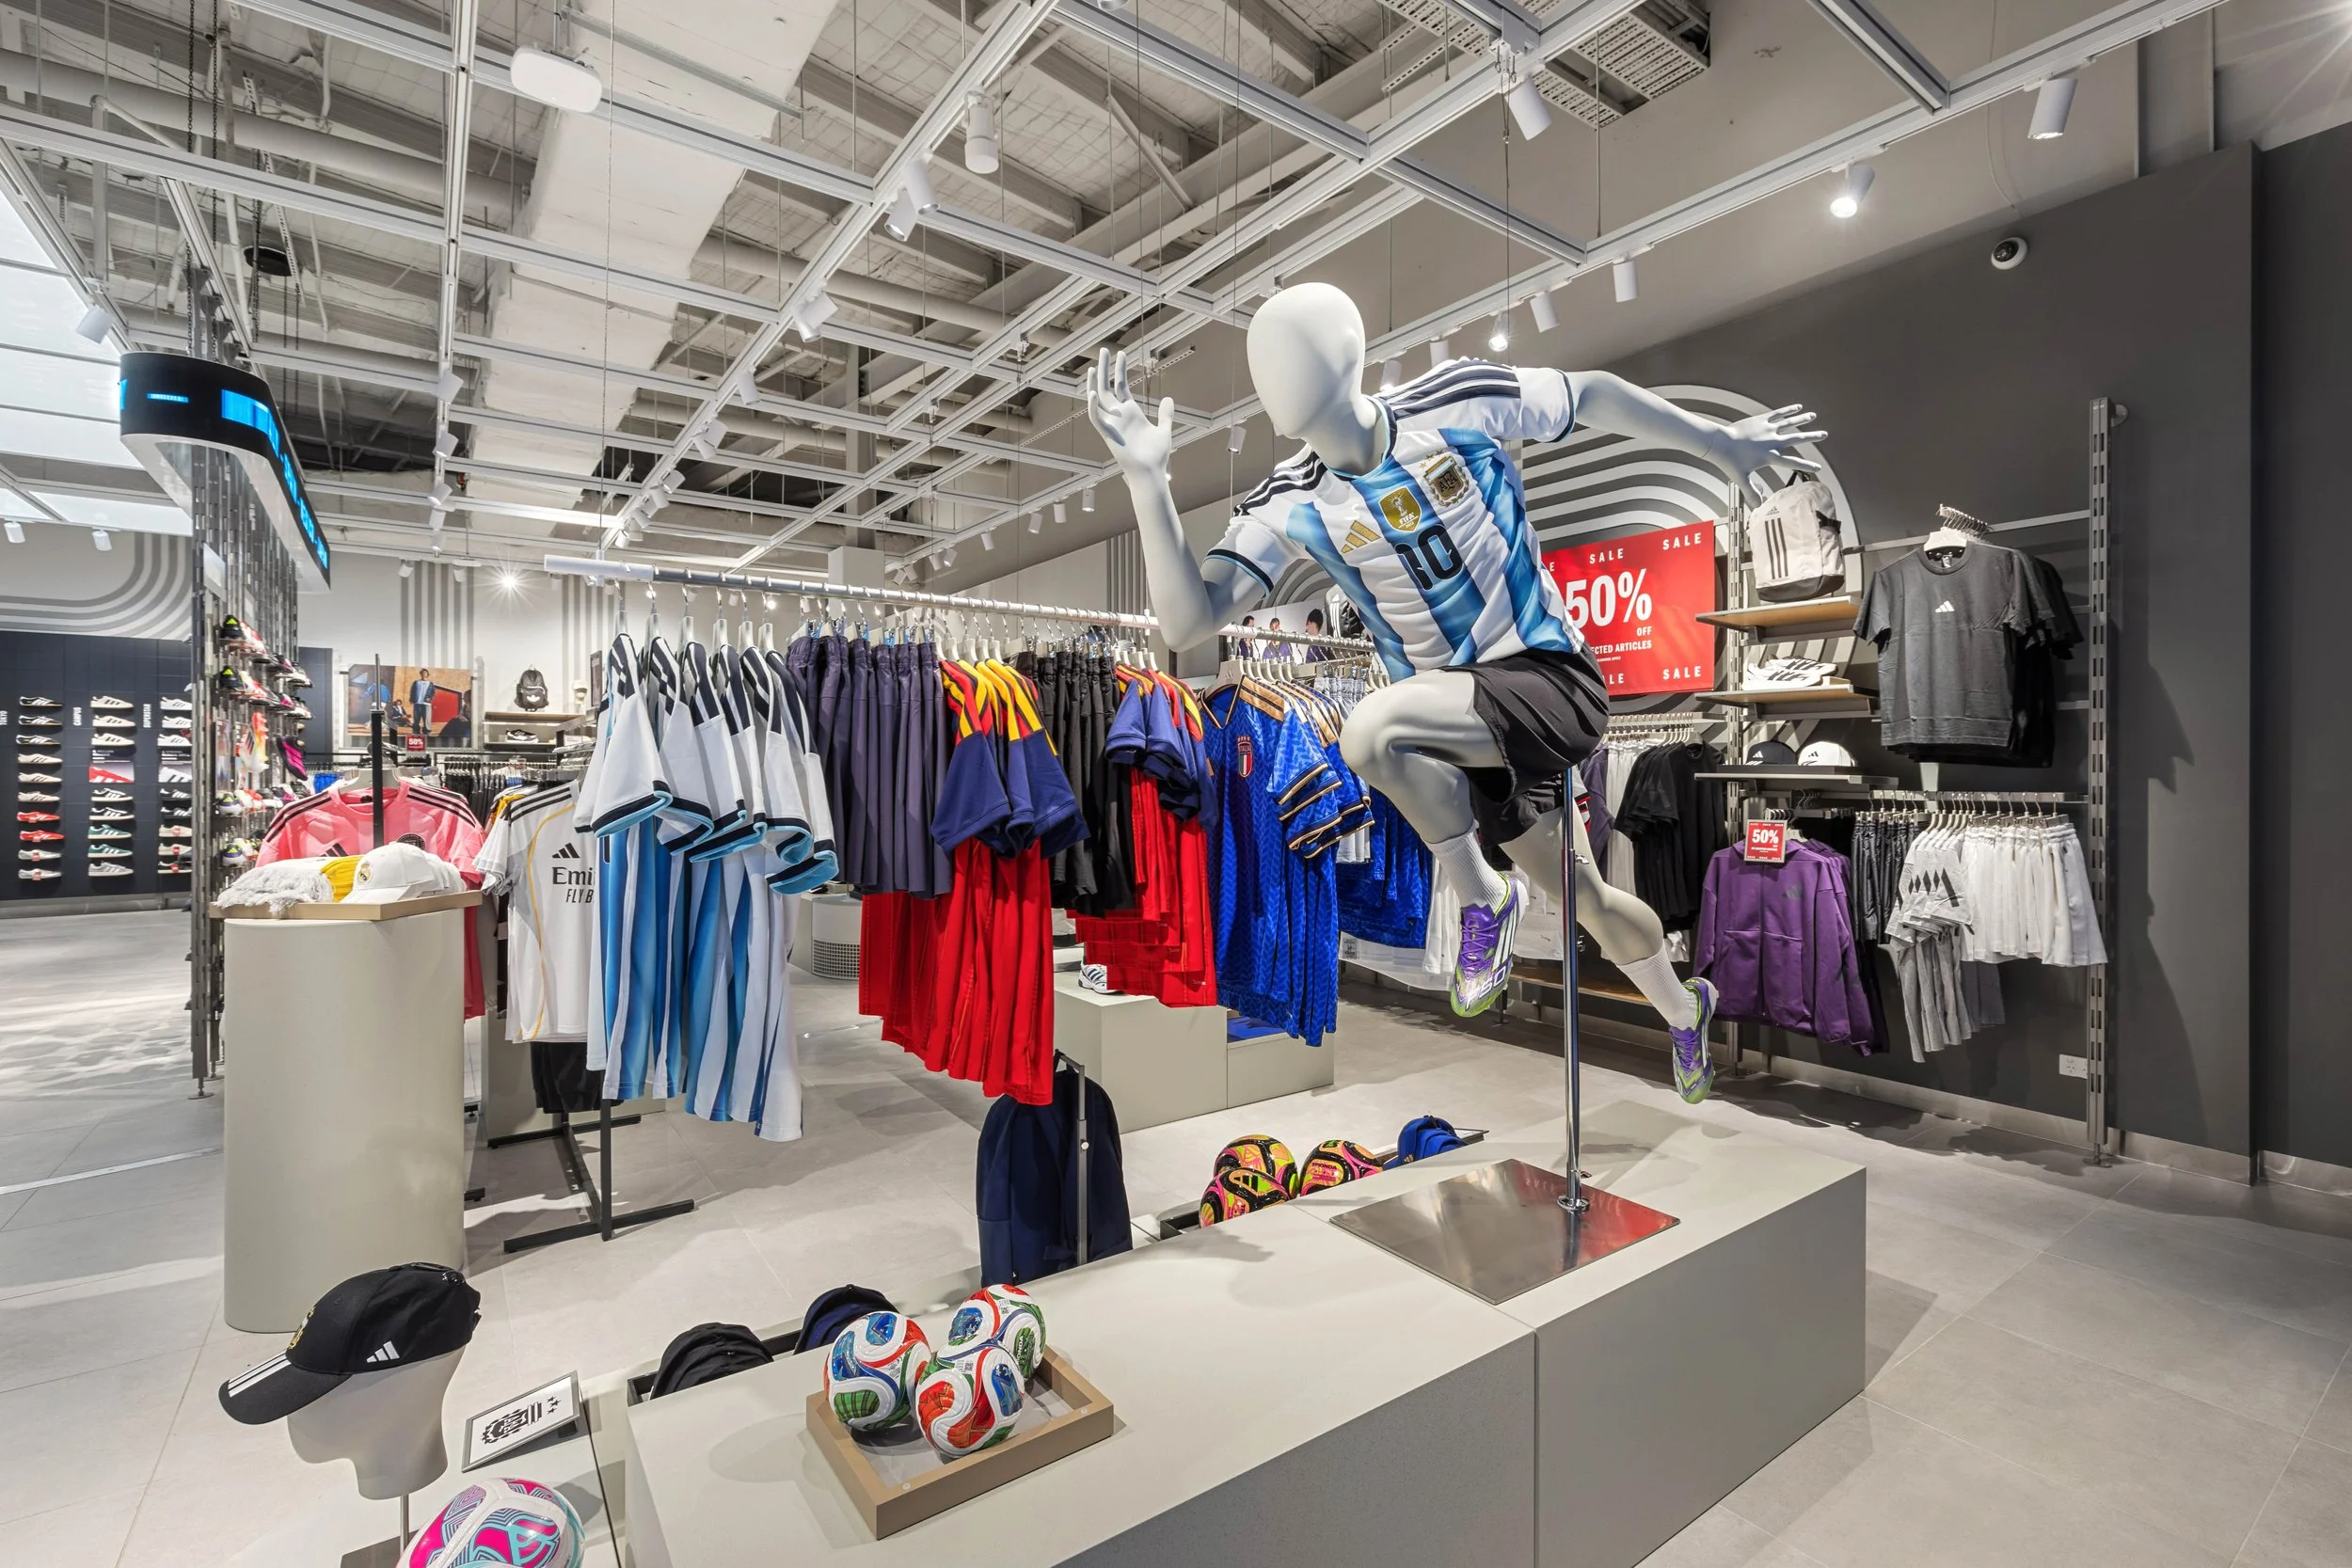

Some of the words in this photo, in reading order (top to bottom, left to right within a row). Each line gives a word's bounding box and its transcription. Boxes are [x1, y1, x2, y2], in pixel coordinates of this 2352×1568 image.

[1399, 513, 1414, 525] FIFA
[1589, 548, 1624, 564] SALE
[1663, 532, 1701, 550] SALE
[1394, 523, 1464, 592] 10
[1565, 568, 1653, 629] 50%
[1636, 626, 1652, 637] OFF
[1614, 640, 1652, 652] ARTICLES
[1663, 666, 1701, 680] SALE
[72, 706, 82, 726] CAMPUS
[1752, 829, 1779, 844] 50%
[551, 866, 595, 886] Emi
[565, 888, 584, 904] FLY
[585, 889, 595, 904] B
